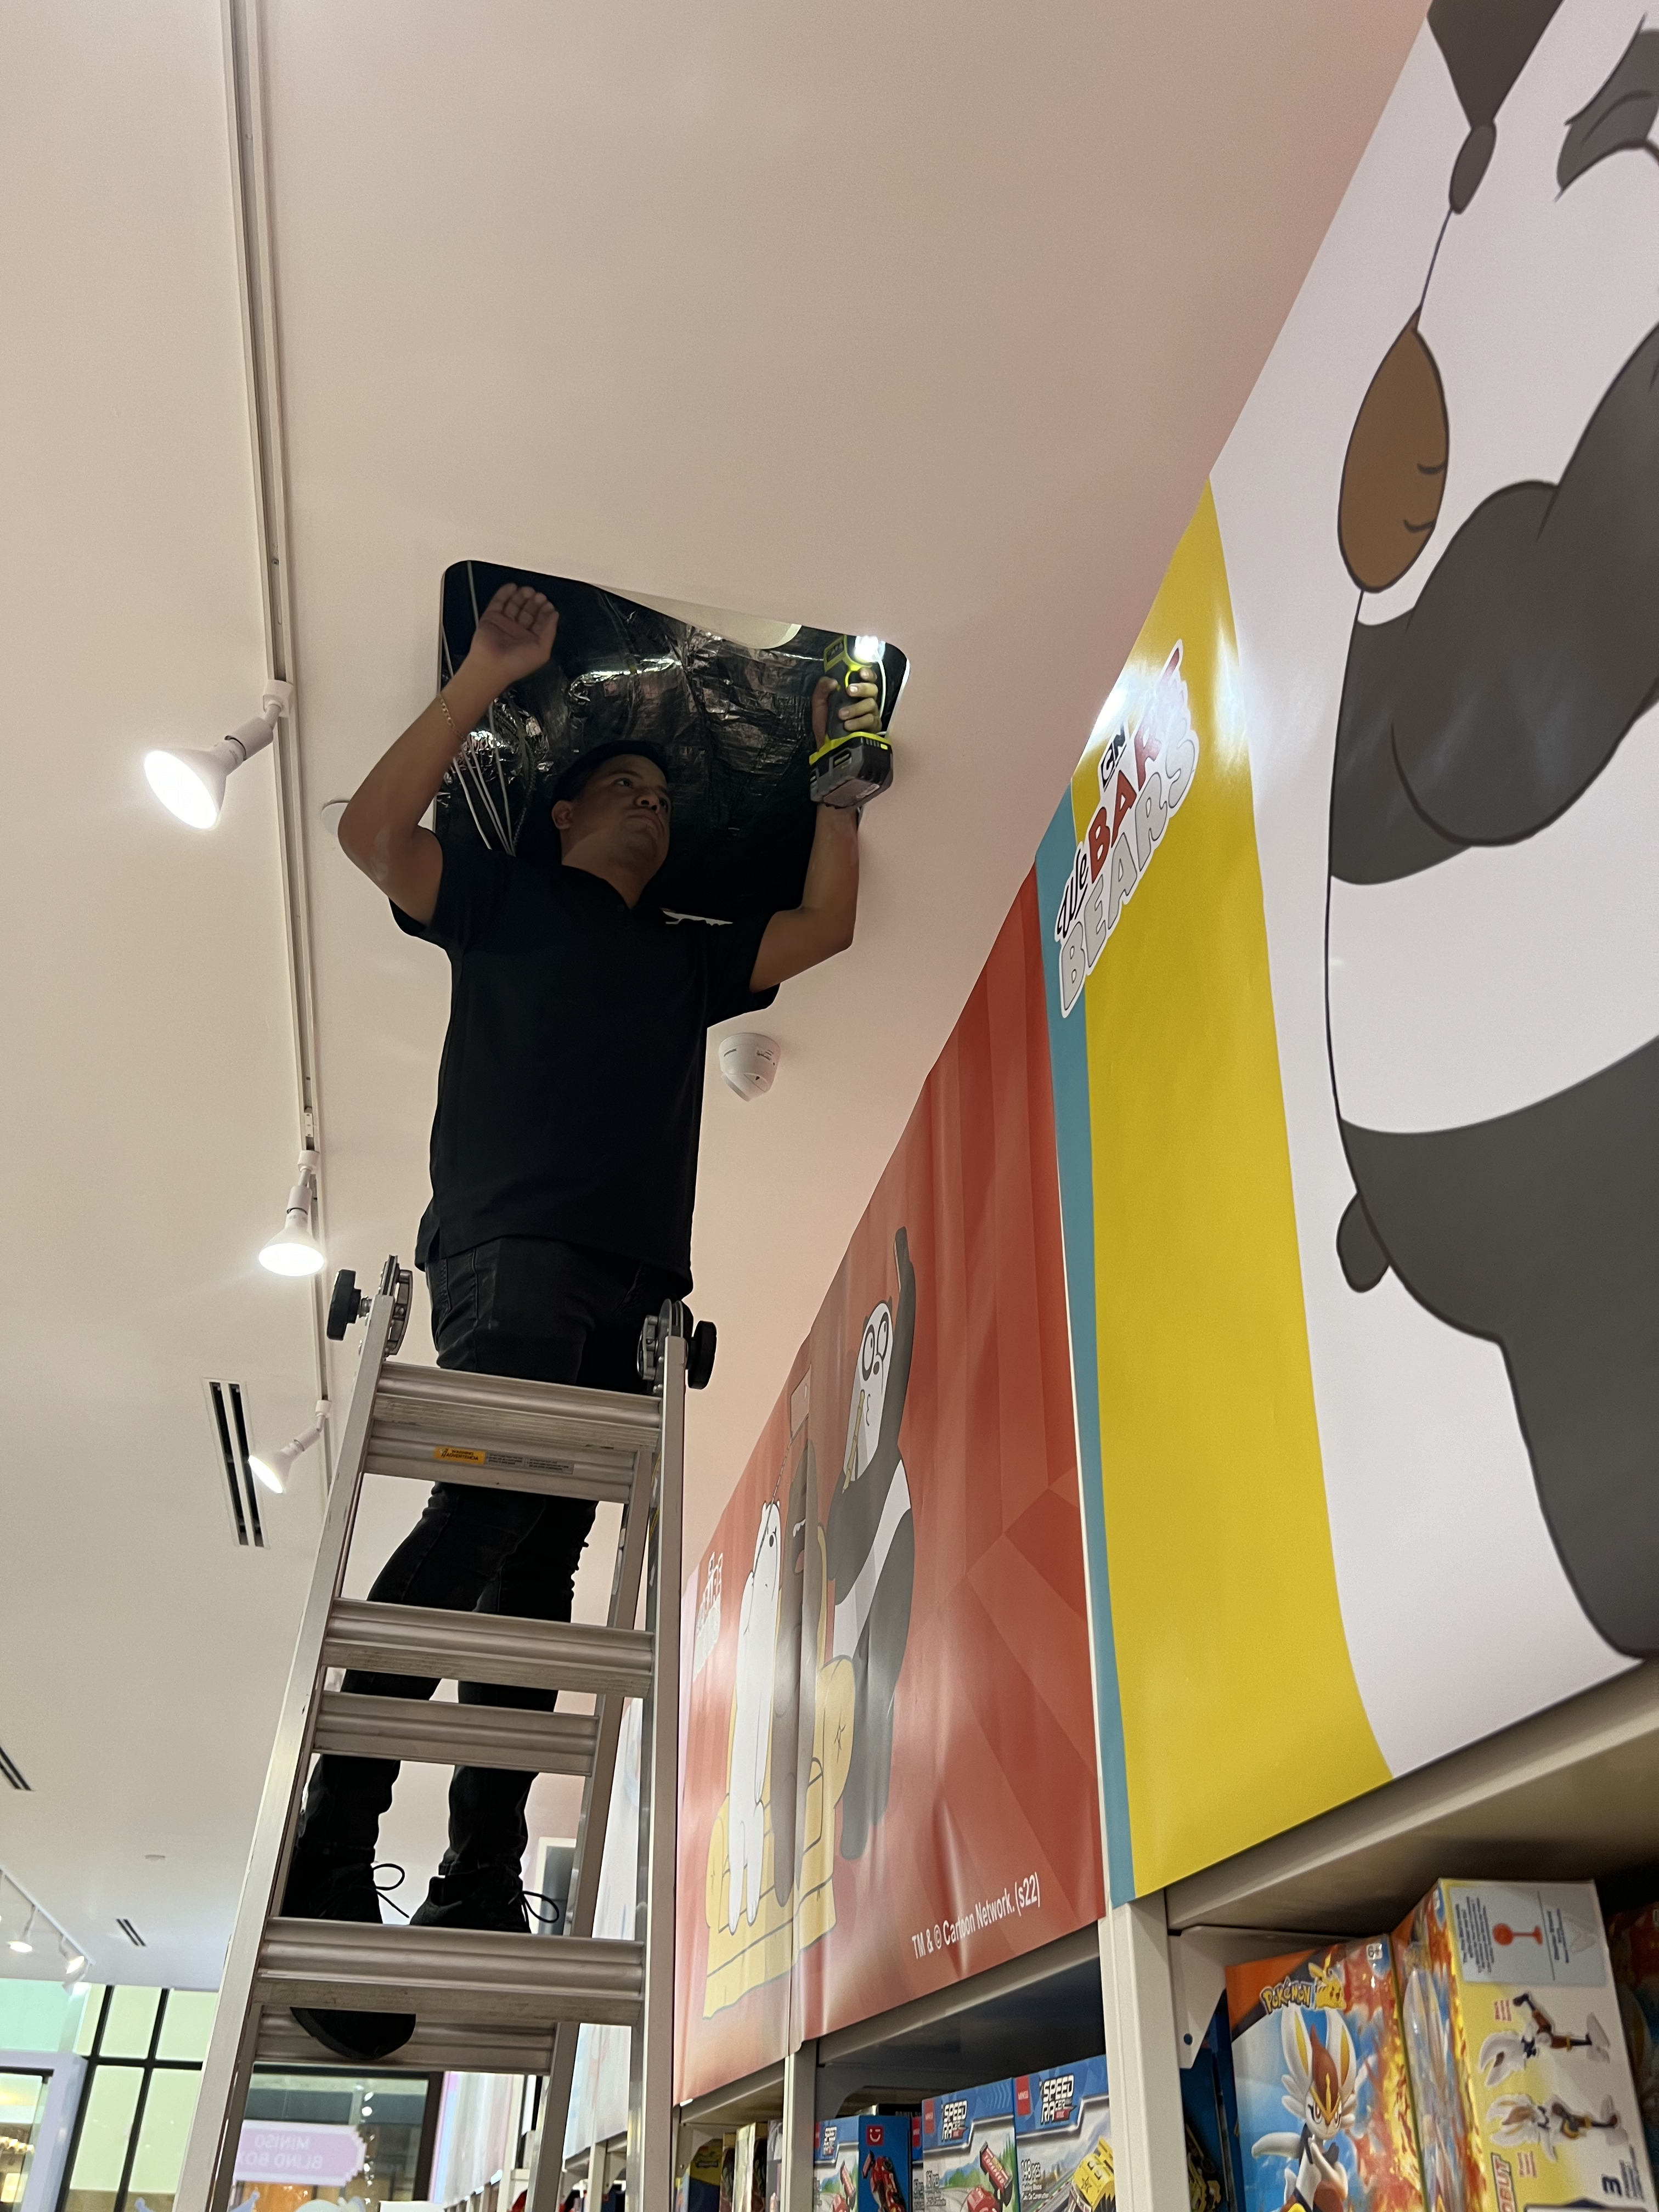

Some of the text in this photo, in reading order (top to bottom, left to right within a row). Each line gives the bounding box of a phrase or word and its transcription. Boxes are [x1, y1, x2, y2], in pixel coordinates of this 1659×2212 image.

[1057, 847, 1088, 939] We
[1061, 716, 1195, 1011] BEARS
[911, 1871, 1040, 1959] TM & © Cartoon Network. (s22)
[944, 2100, 967, 2123] SPEED
[1043, 2074, 1074, 2103] SPEED
